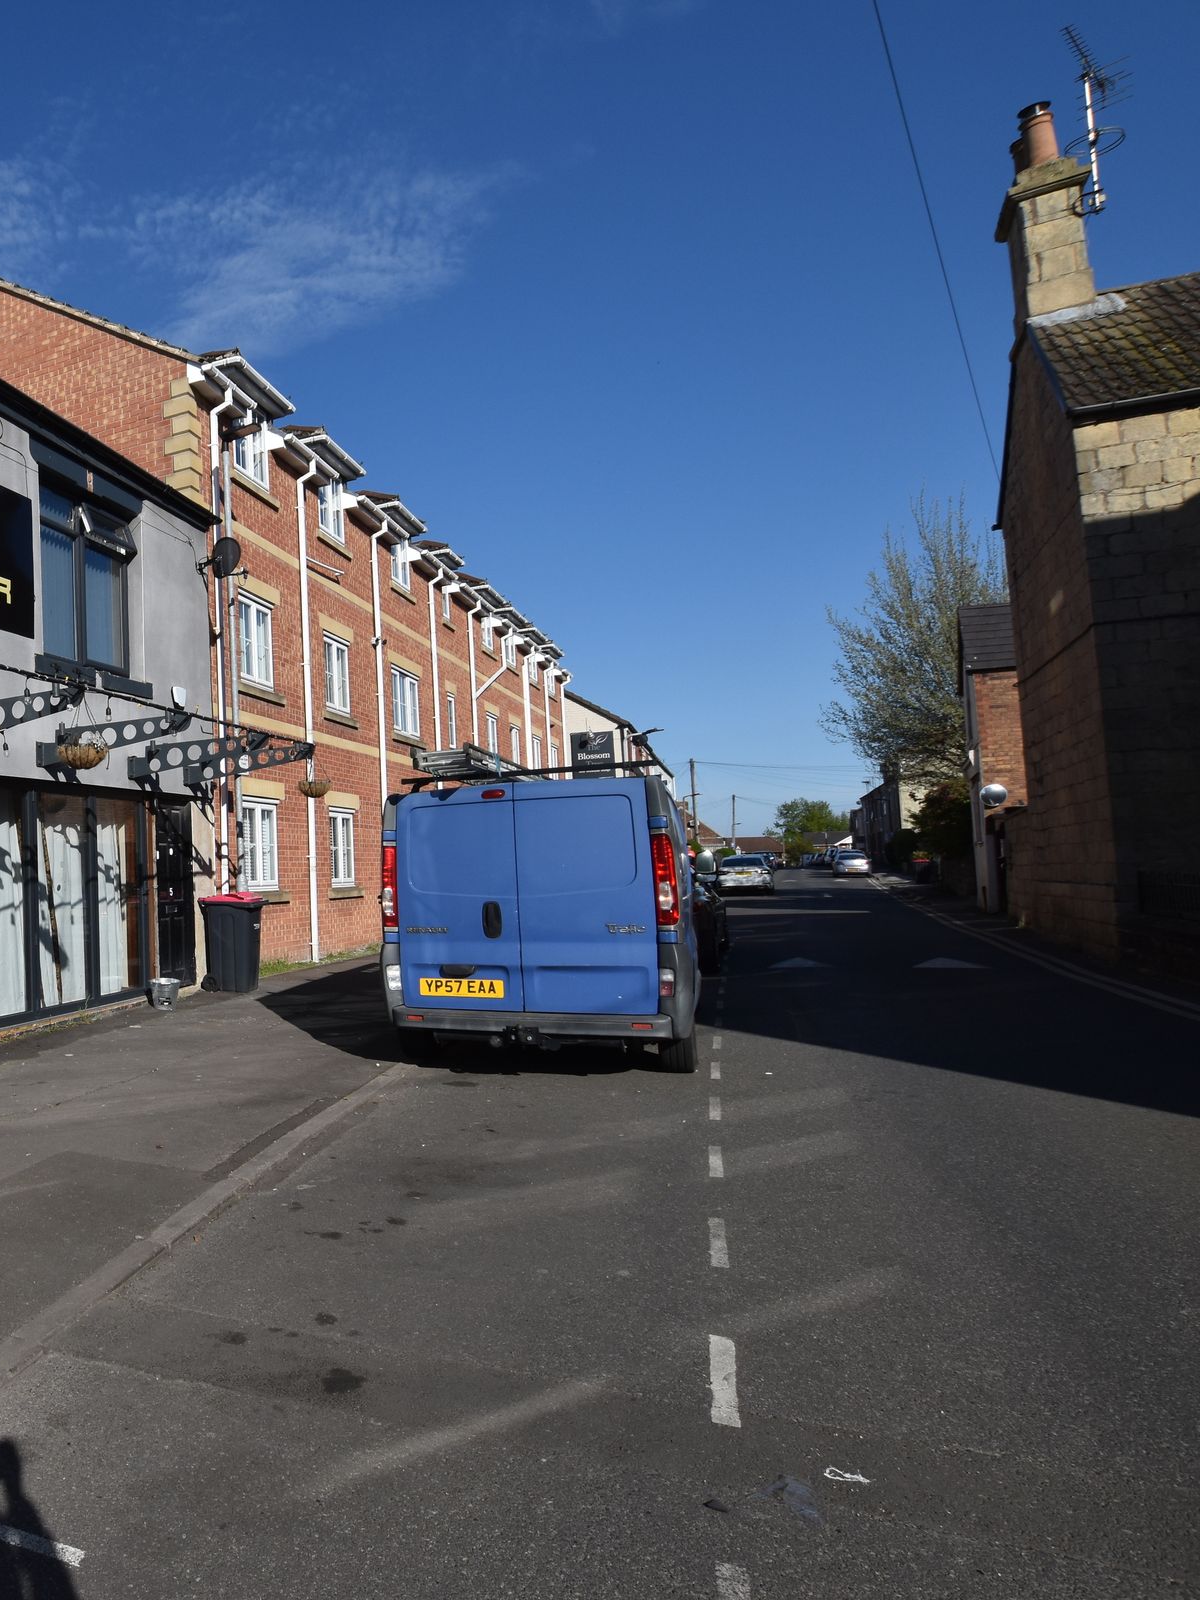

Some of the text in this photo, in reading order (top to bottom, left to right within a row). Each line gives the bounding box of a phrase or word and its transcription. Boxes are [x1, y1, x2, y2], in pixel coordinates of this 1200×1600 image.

[577, 752, 611, 761] Blossom
[169, 887, 174, 897] 5
[425, 979, 497, 994] YP57 EAA
